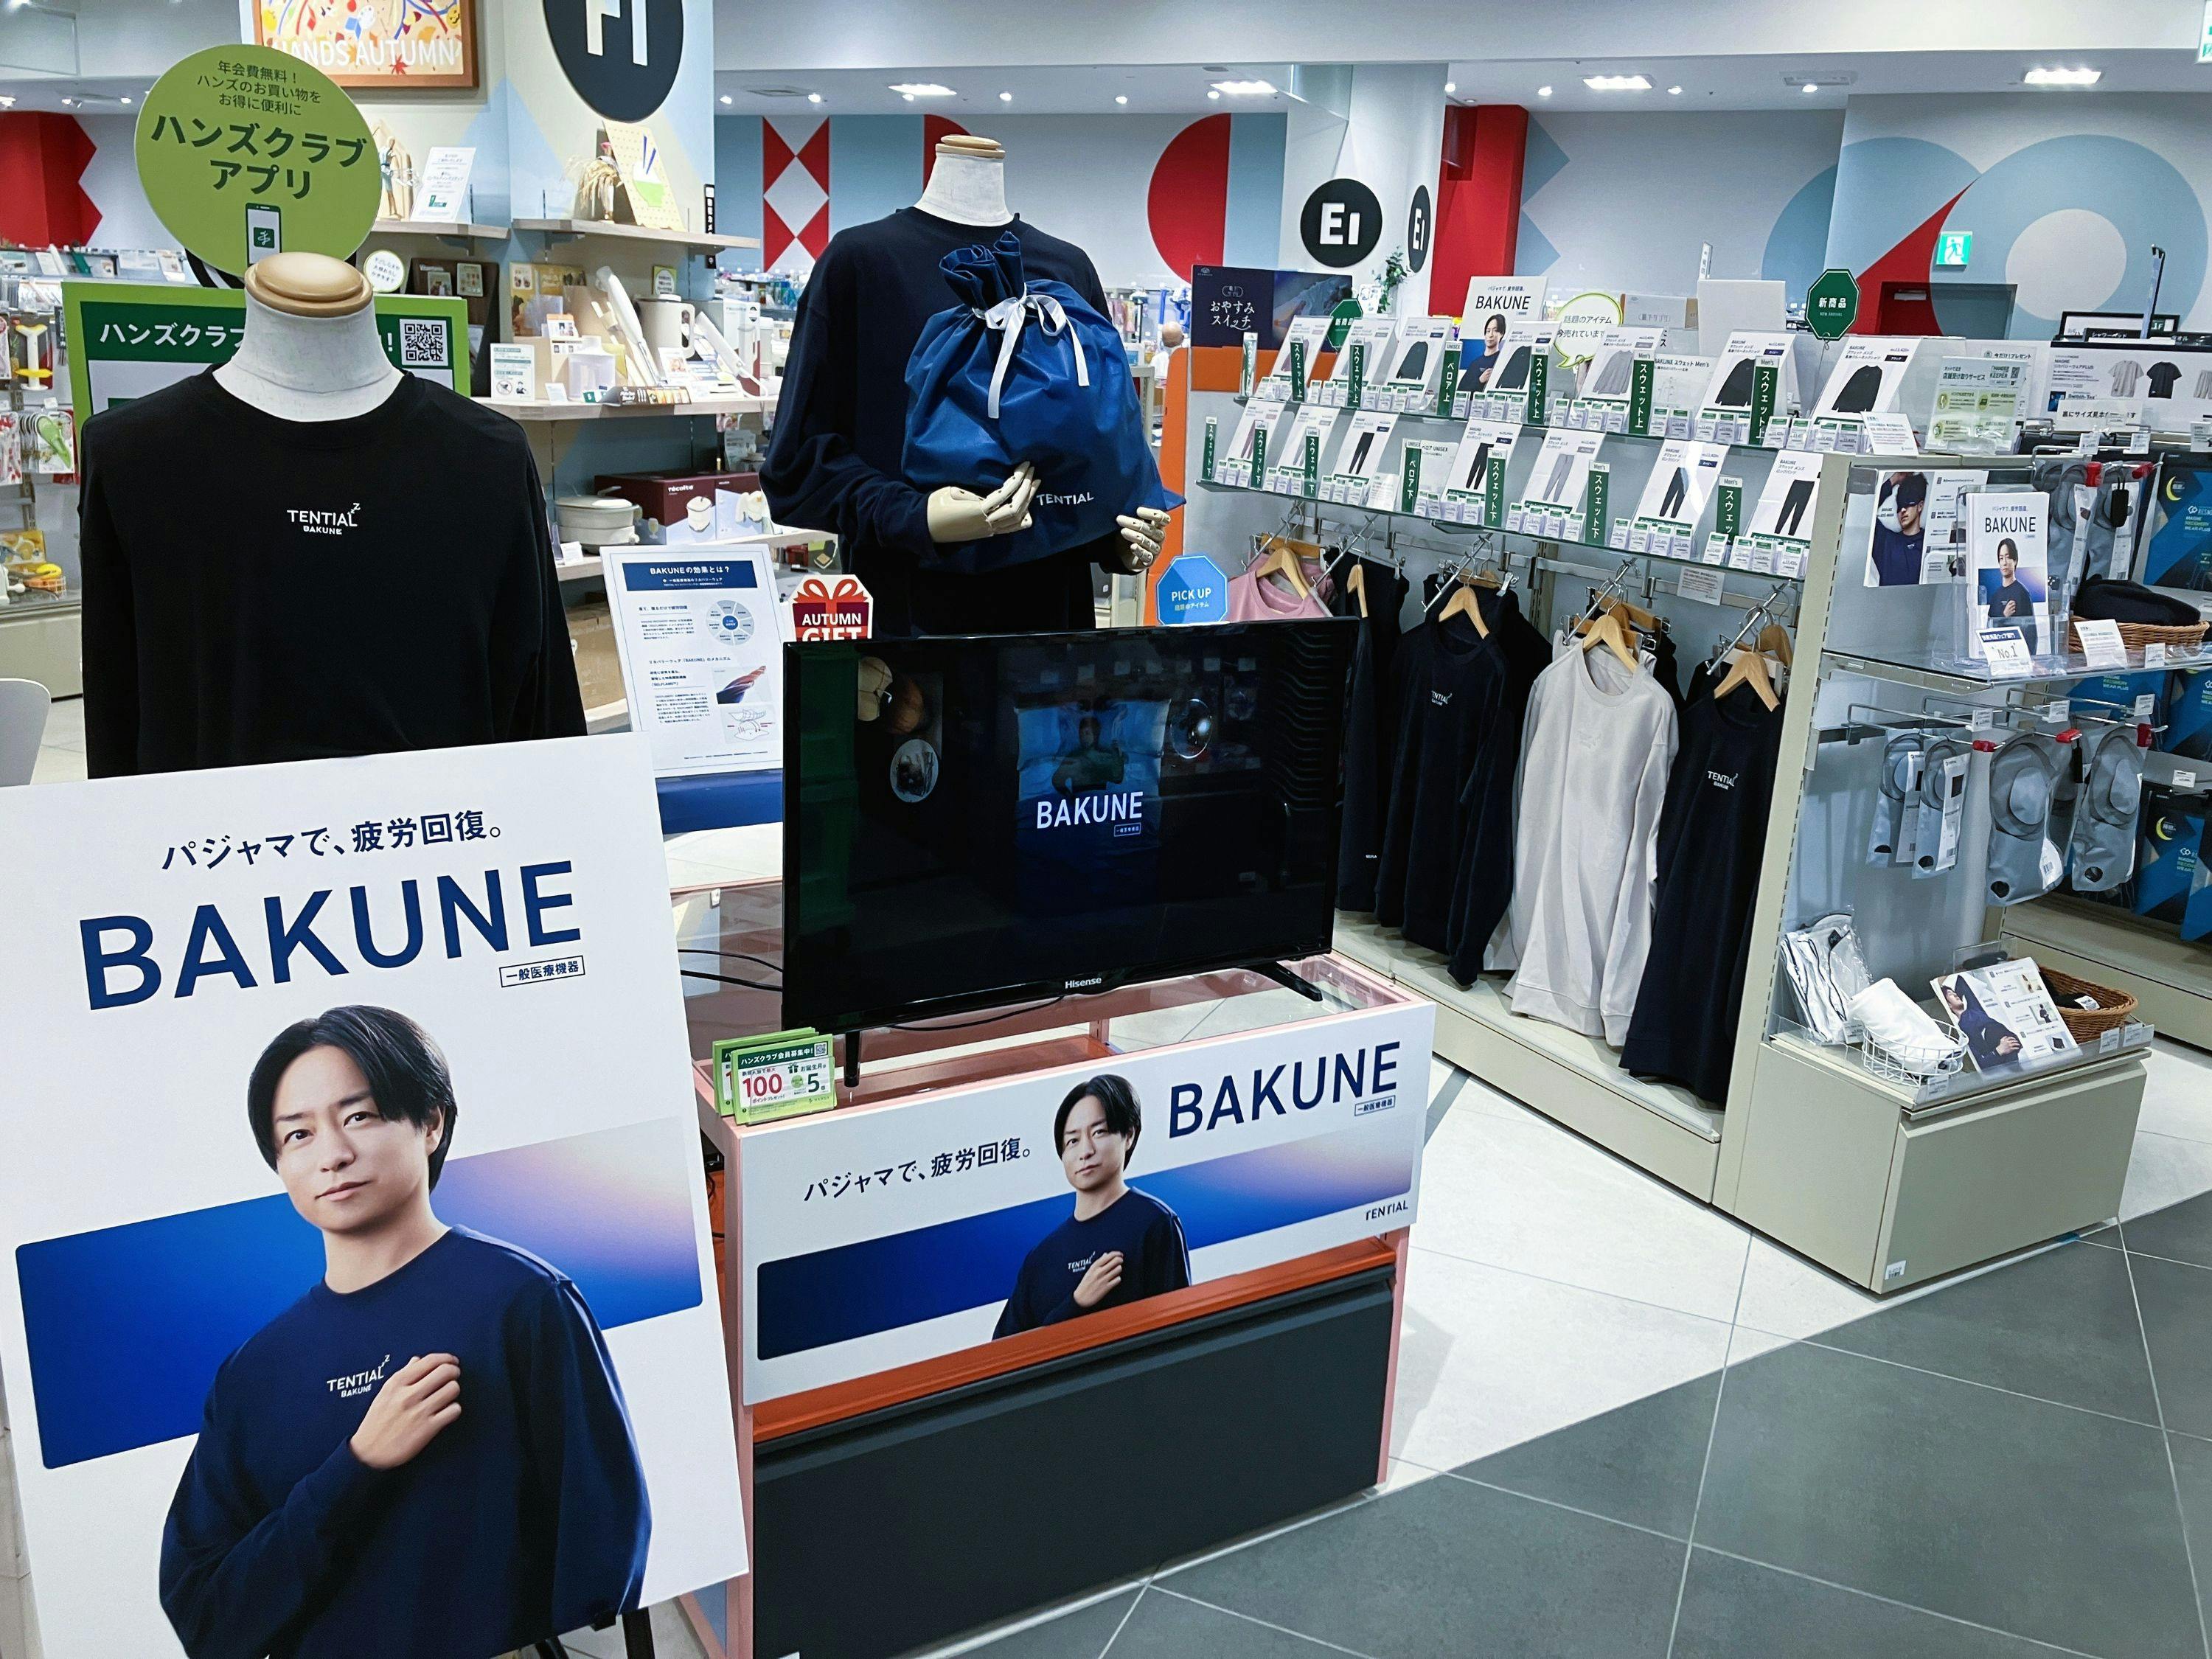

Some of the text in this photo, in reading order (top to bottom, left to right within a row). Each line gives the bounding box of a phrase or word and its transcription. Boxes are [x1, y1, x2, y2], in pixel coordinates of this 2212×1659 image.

[355, 39, 456, 66] AUTUMN
[218, 60, 297, 83] 年会費無料！
[198, 74, 321, 103] ハンズのお買い物を
[219, 94, 301, 116] お得に便利に
[151, 114, 368, 167] ハンズクラブ
[209, 160, 311, 199] アプリ
[1210, 300, 1255, 315] おやすみ
[1475, 296, 1531, 310] BAKUNE
[1818, 297, 1847, 309] 新商品
[1211, 315, 1251, 330] スイッチ
[1563, 316, 1612, 324] 話題のアイテム
[1293, 344, 1304, 398] スウェット上
[1353, 347, 1362, 403] スウェット上
[1443, 362, 1455, 403] ベロア上
[1532, 358, 1543, 419] スウェット上
[1635, 364, 1648, 429] スウェット上
[1756, 370, 1771, 439] スウェット上
[1256, 431, 1264, 484] スウェット下
[1408, 459, 1416, 500] ベロア下
[1490, 461, 1500, 522] スウェット下
[1037, 491, 1094, 506] TENTIAL
[1591, 474, 1603, 538] スウェット下
[287, 509, 358, 527] TENTIAL
[1725, 490, 1734, 534] スウェッ
[303, 525, 342, 535] BAKUNE
[1985, 517, 2037, 533] BAKUNE
[650, 565, 730, 575] BAKUNEの効果とは？
[1171, 587, 1211, 602] PICK UP
[802, 613, 862, 626] AUTUMN
[1997, 645, 2018, 660] No.1
[1708, 771, 1735, 787] TENTIAL
[1037, 791, 1144, 829] BAKUNE
[161, 810, 503, 872] パジャマで、疲労回復。
[80, 859, 581, 1011] BAKUNE
[504, 959, 581, 985] 一般医療機器
[1065, 976, 1102, 990] Hisense
[742, 1073, 782, 1098] 100
[807, 1073, 820, 1093] 5
[1169, 1041, 1400, 1138] BAKUNE
[1357, 1098, 1394, 1115] 一般医療機器
[804, 1136, 1032, 1203] パジャマで、疲労回復。
[1366, 1200, 1409, 1222] TENTIAL
[1068, 1256, 1092, 1270] TENTIAL
[327, 1366, 385, 1392] TENTIAL
[341, 1383, 372, 1398] BAKUNE
